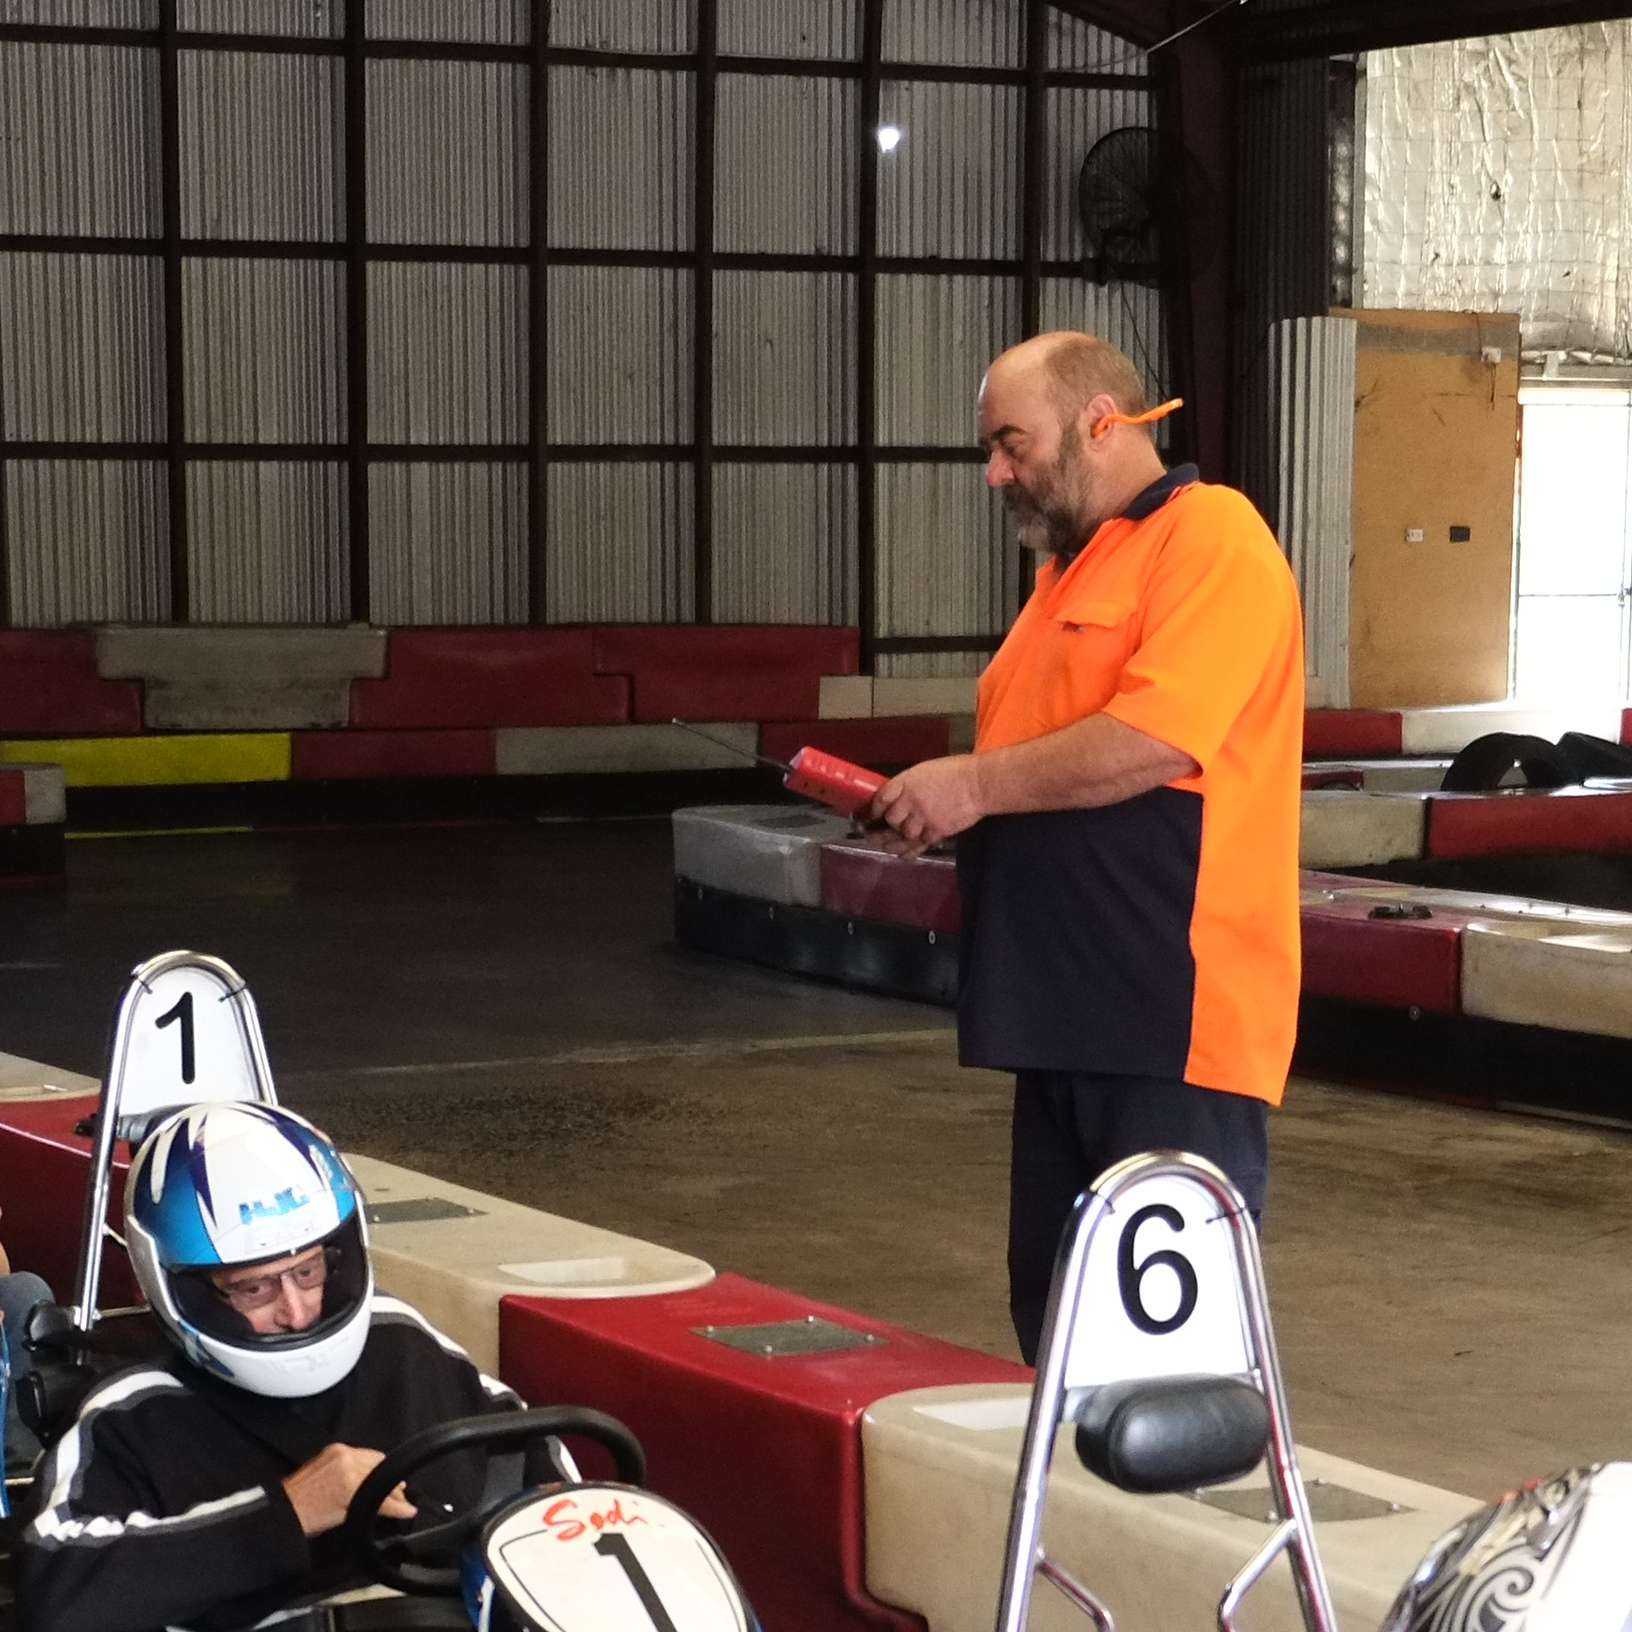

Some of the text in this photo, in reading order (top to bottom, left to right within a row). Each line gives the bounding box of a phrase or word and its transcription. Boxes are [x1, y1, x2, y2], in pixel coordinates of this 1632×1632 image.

[154, 990, 196, 1085] 1
[1117, 1203, 1199, 1336] 6
[541, 1498, 650, 1542] Sodi
